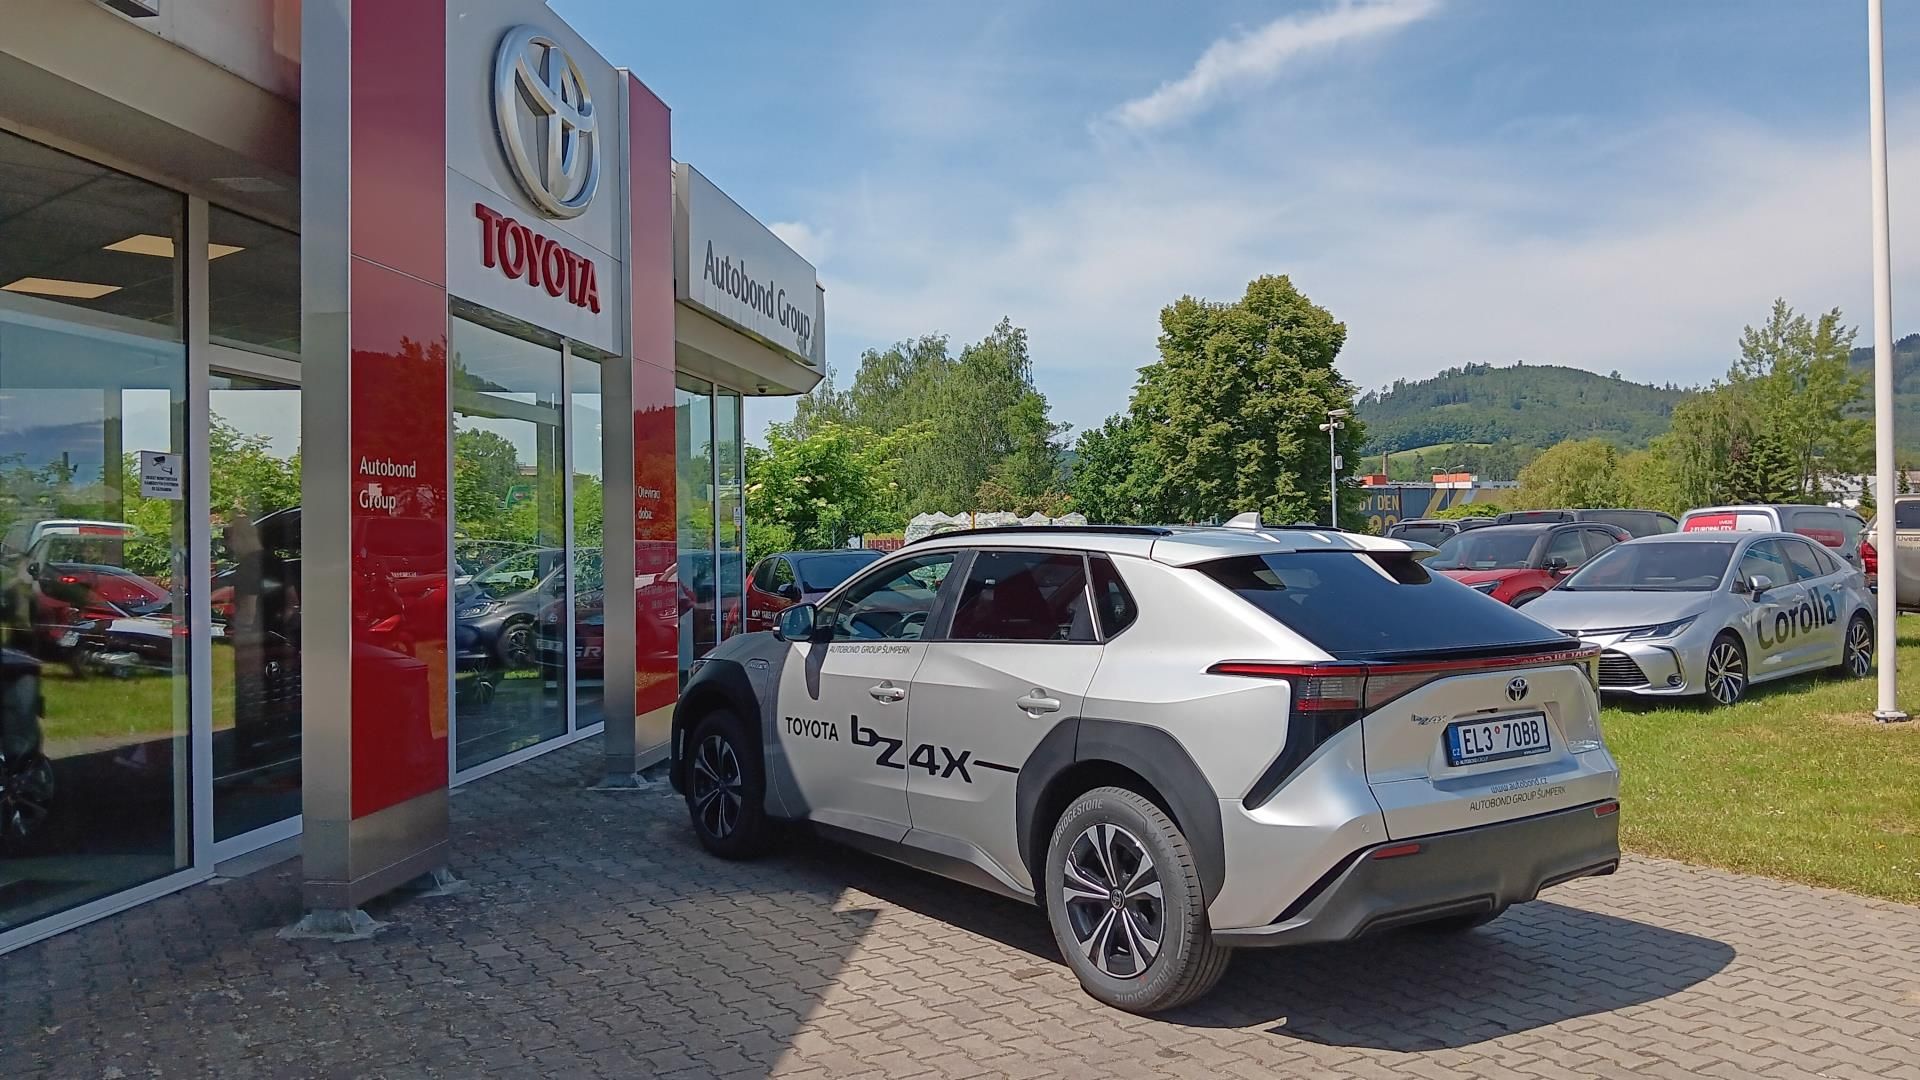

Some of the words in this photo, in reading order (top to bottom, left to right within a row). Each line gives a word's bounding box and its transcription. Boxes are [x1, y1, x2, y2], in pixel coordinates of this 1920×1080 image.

[475, 203, 600, 314] TOYOTA
[704, 240, 774, 319] Autobond
[777, 288, 811, 350] Group
[360, 455, 416, 478] Autobond
[360, 489, 396, 515] Group
[1378, 495, 1399, 511] DEN
[1756, 586, 1838, 650] Corolla
[829, 645, 860, 654] AUTOBOND
[861, 645, 882, 654] GROUP
[785, 717, 839, 742] TOYOTA
[1463, 726, 1494, 755] EL3
[1503, 720, 1541, 748] 70BB
[1452, 748, 1461, 756] CZ
[1490, 776, 1548, 794] www.autobond.cz
[1469, 795, 1513, 812] AUTOBOND
[1512, 791, 1537, 805] GROUP
[1537, 785, 1566, 800] ŠUMPERK
[1054, 799, 1103, 848] BRIDGESTONE
